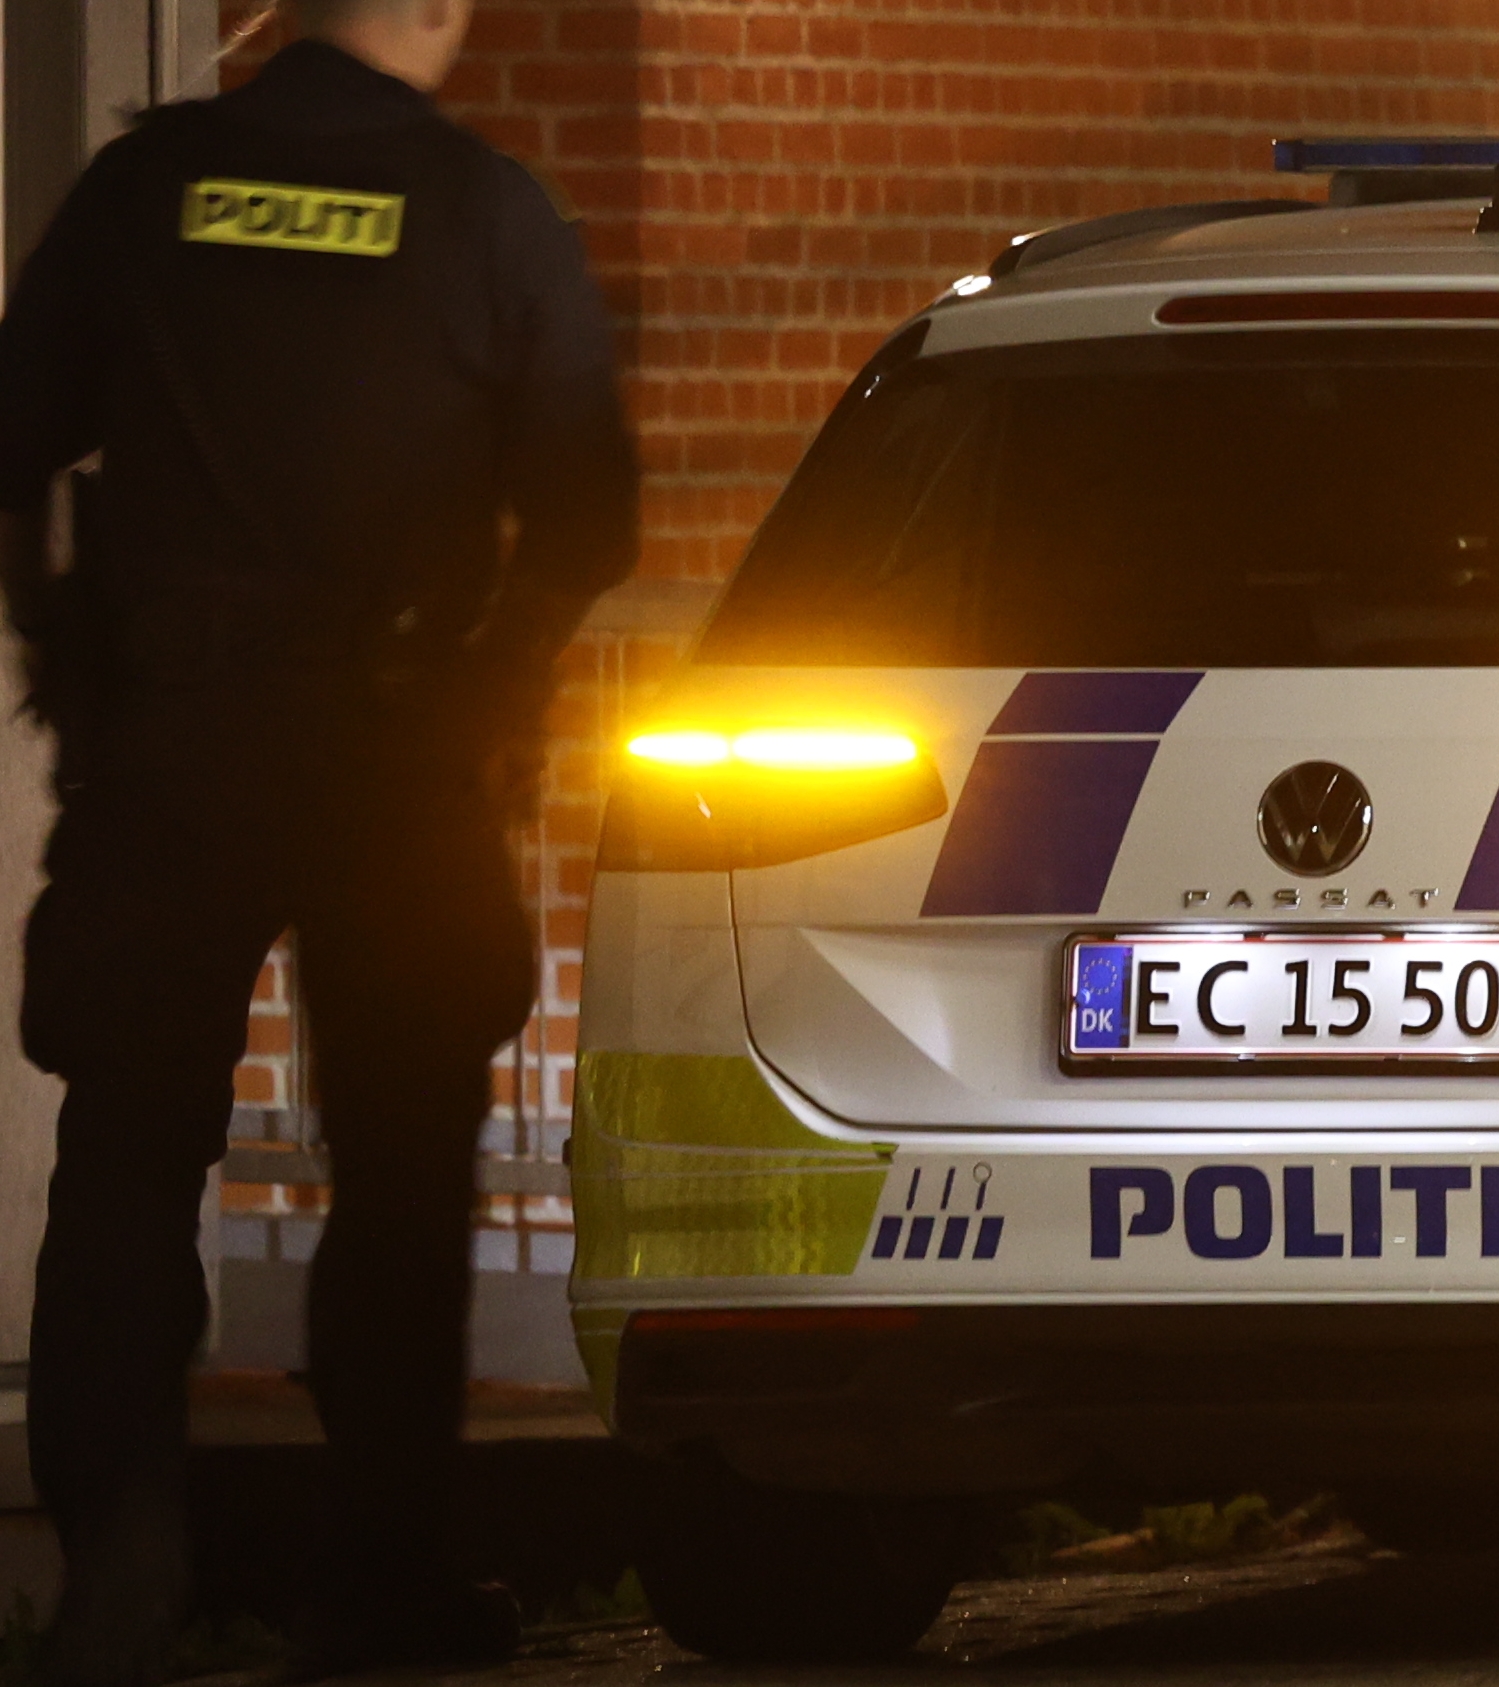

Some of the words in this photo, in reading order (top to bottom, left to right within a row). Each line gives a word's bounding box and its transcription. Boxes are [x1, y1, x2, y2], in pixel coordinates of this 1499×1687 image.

[202, 192, 396, 246] POLITI
[1183, 888, 1440, 910] PASSAT
[1136, 960, 1249, 1036] EC
[1282, 959, 1372, 1037] 15
[1081, 1008, 1114, 1033] DK
